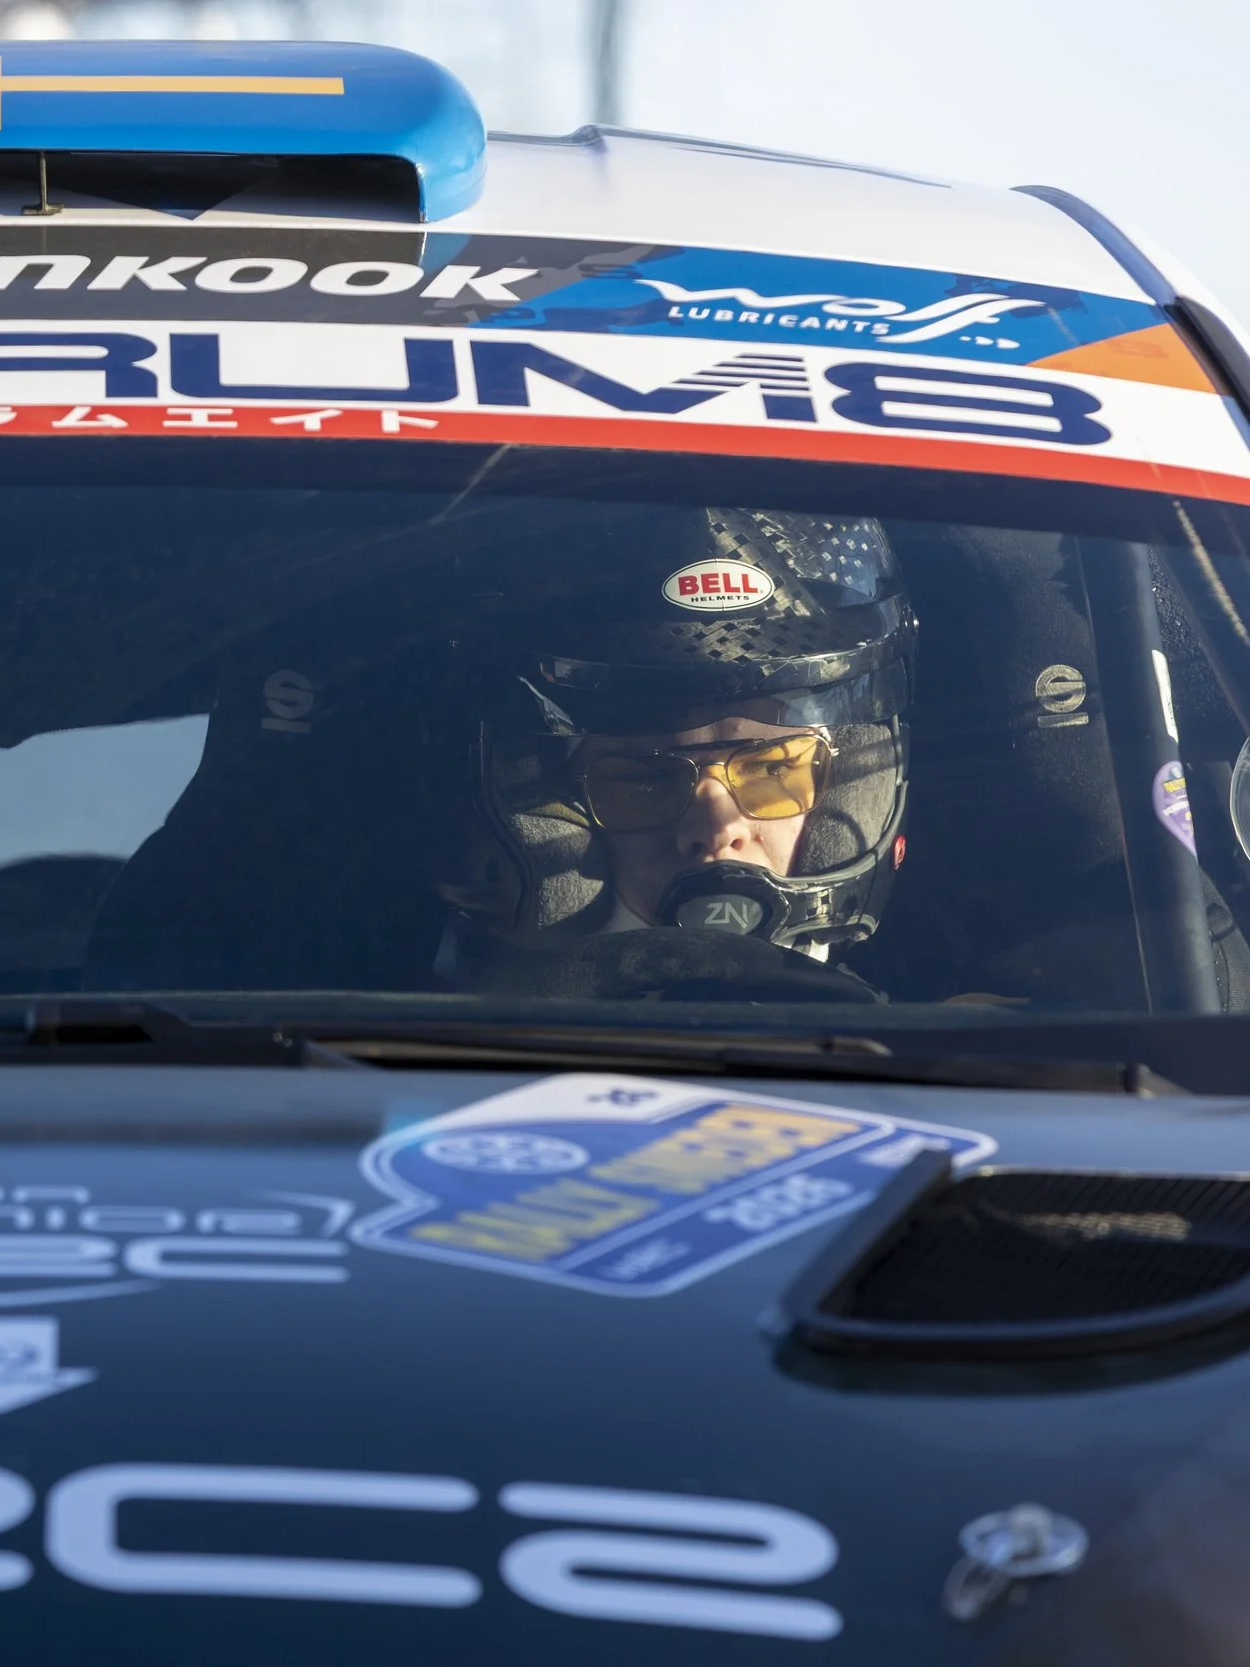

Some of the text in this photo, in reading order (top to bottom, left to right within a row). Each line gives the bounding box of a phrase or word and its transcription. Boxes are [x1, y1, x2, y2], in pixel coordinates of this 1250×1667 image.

[667, 305, 891, 336] LUBRICANTS
[677, 572, 759, 597] BELL
[690, 595, 750, 603] HELMETS
[704, 901, 749, 930] ZN
